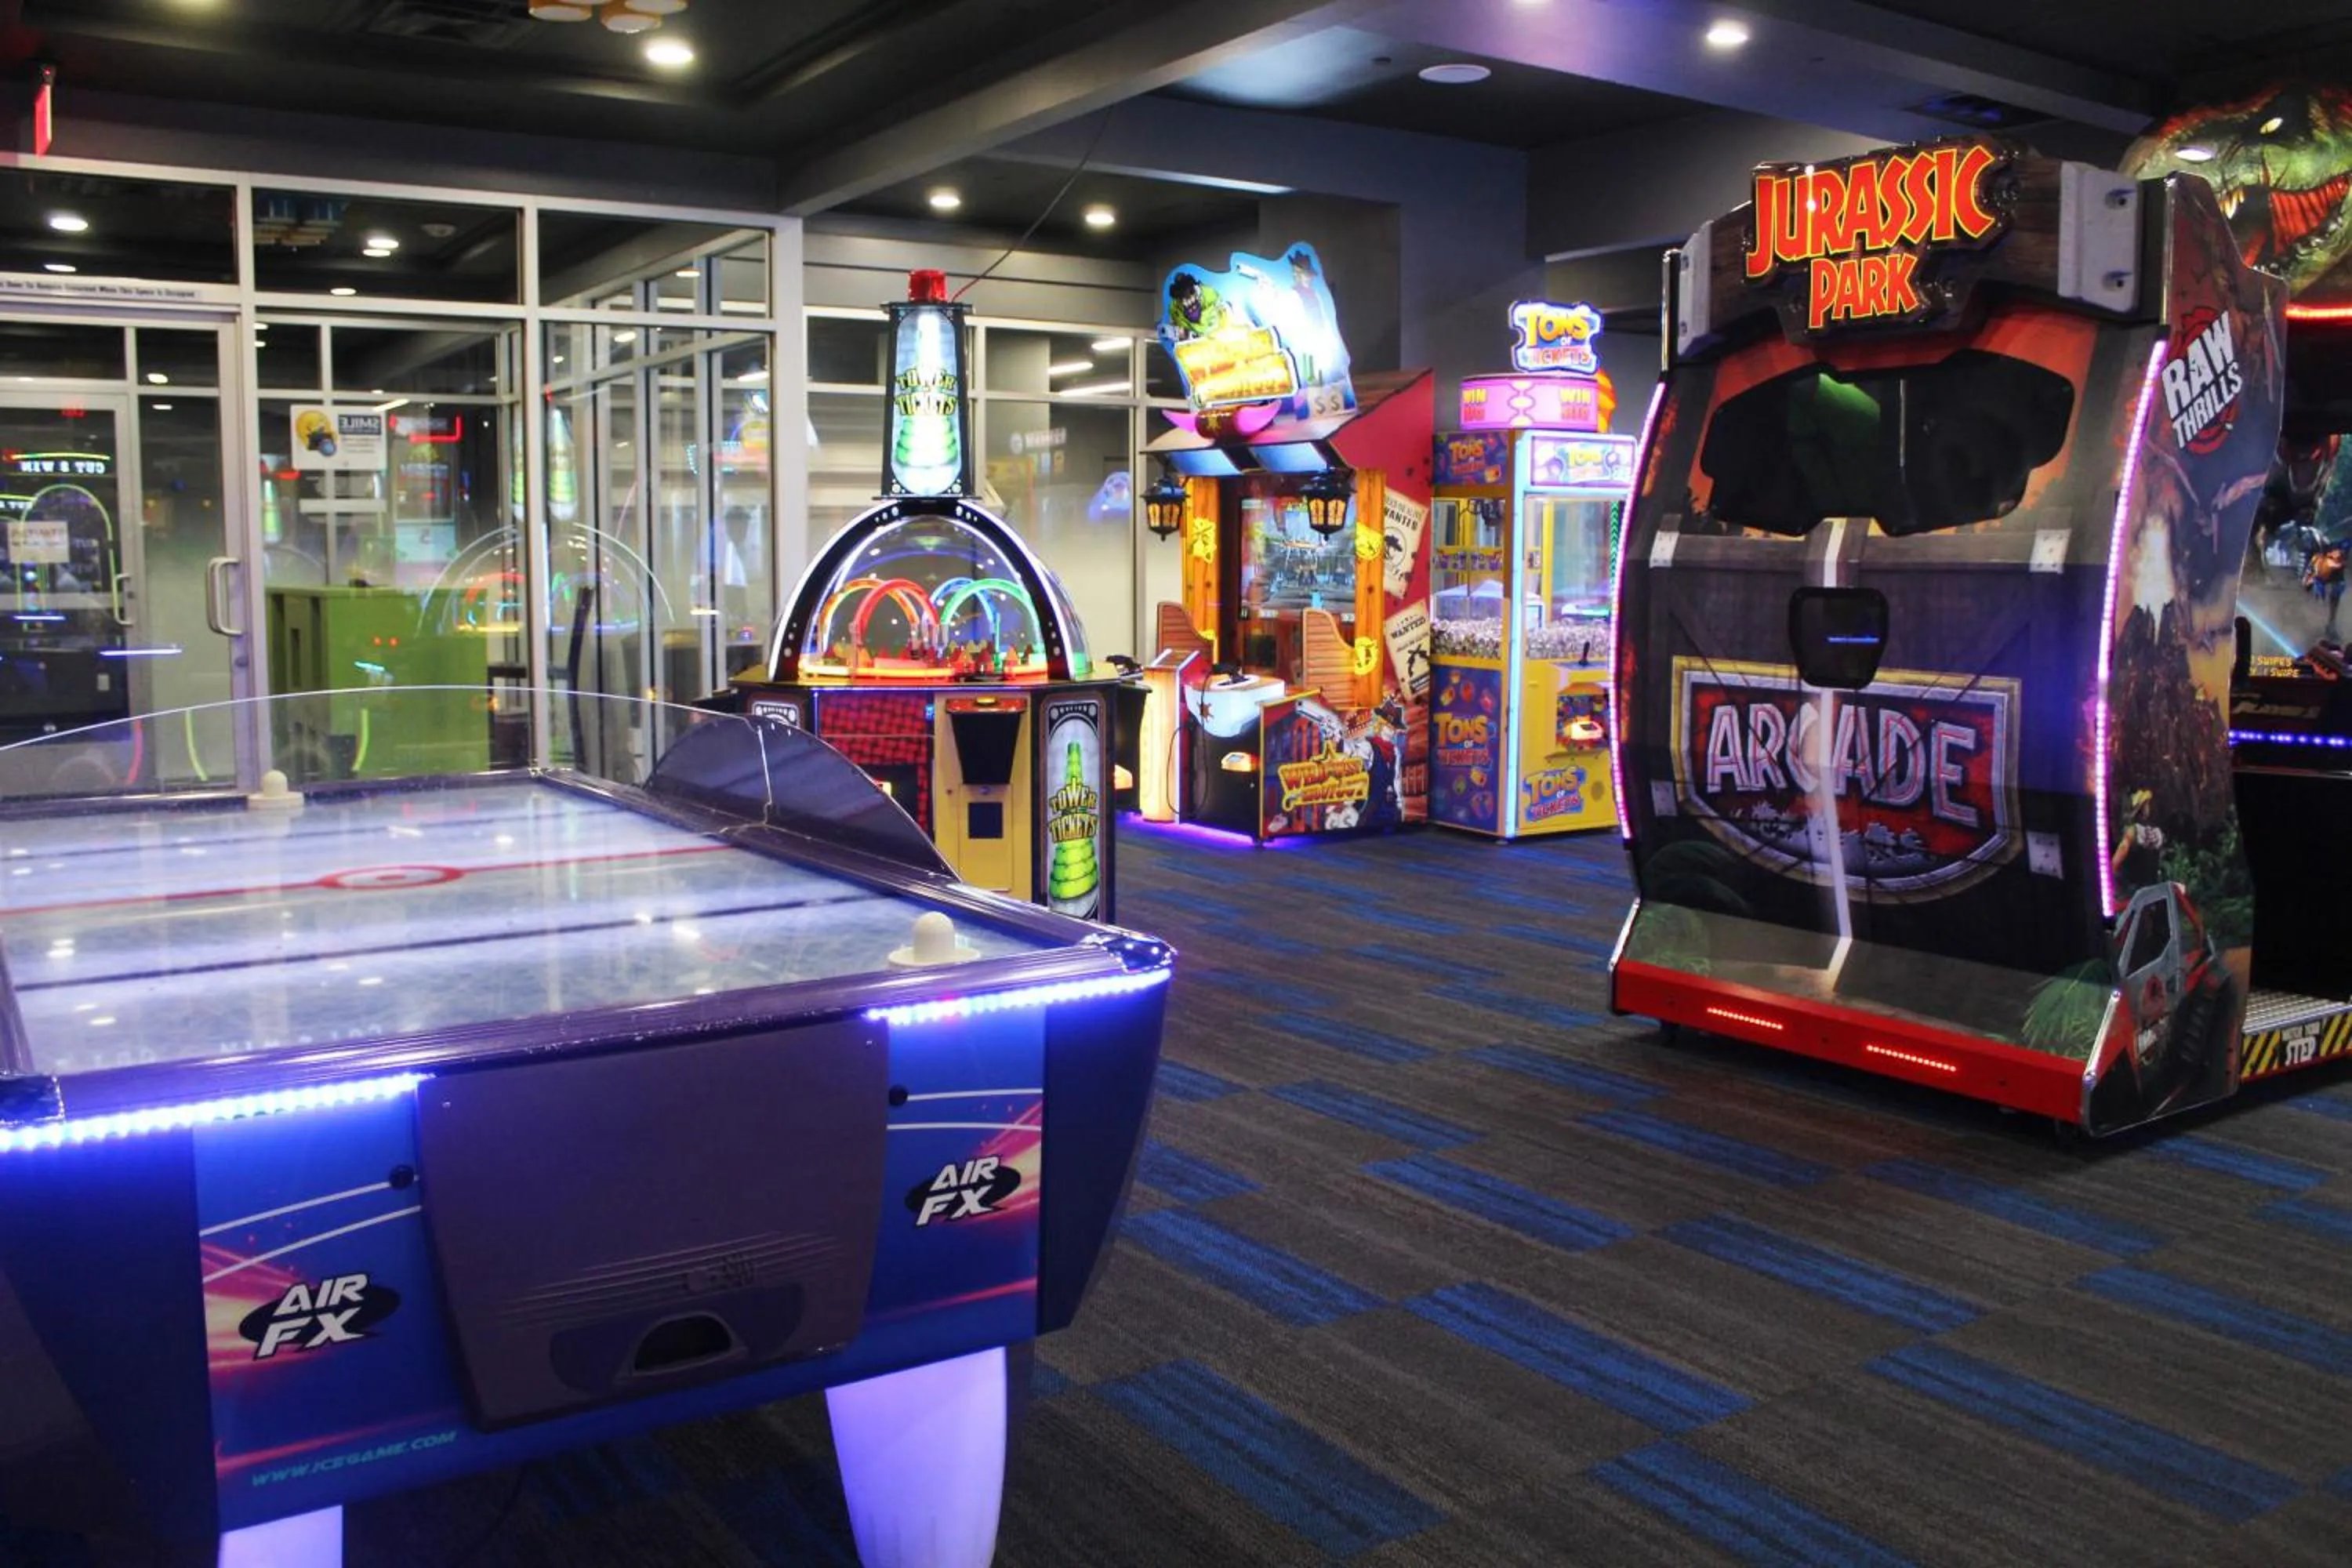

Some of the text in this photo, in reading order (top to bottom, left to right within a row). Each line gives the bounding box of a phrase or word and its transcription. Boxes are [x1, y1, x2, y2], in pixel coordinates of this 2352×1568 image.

[1746, 145, 1995, 278] JURASSIC
[1808, 252, 1919, 329] PARK
[1518, 307, 1592, 347] TONS
[2162, 310, 2234, 419] RAW
[2172, 361, 2243, 448] THRILLS
[1433, 712, 1487, 746] TONS
[1525, 766, 1578, 805] TONS
[1706, 702, 1978, 828] ARCADE
[1049, 776, 1098, 814] TOWER
[1047, 813, 1098, 844] TICKETS
[929, 1155, 1000, 1192] AIR
[915, 1184, 995, 1226] FX
[272, 1273, 368, 1316] AIR
[256, 1306, 365, 1358] FX
[252, 1430, 457, 1486] WWW.ICEGAME.COM
